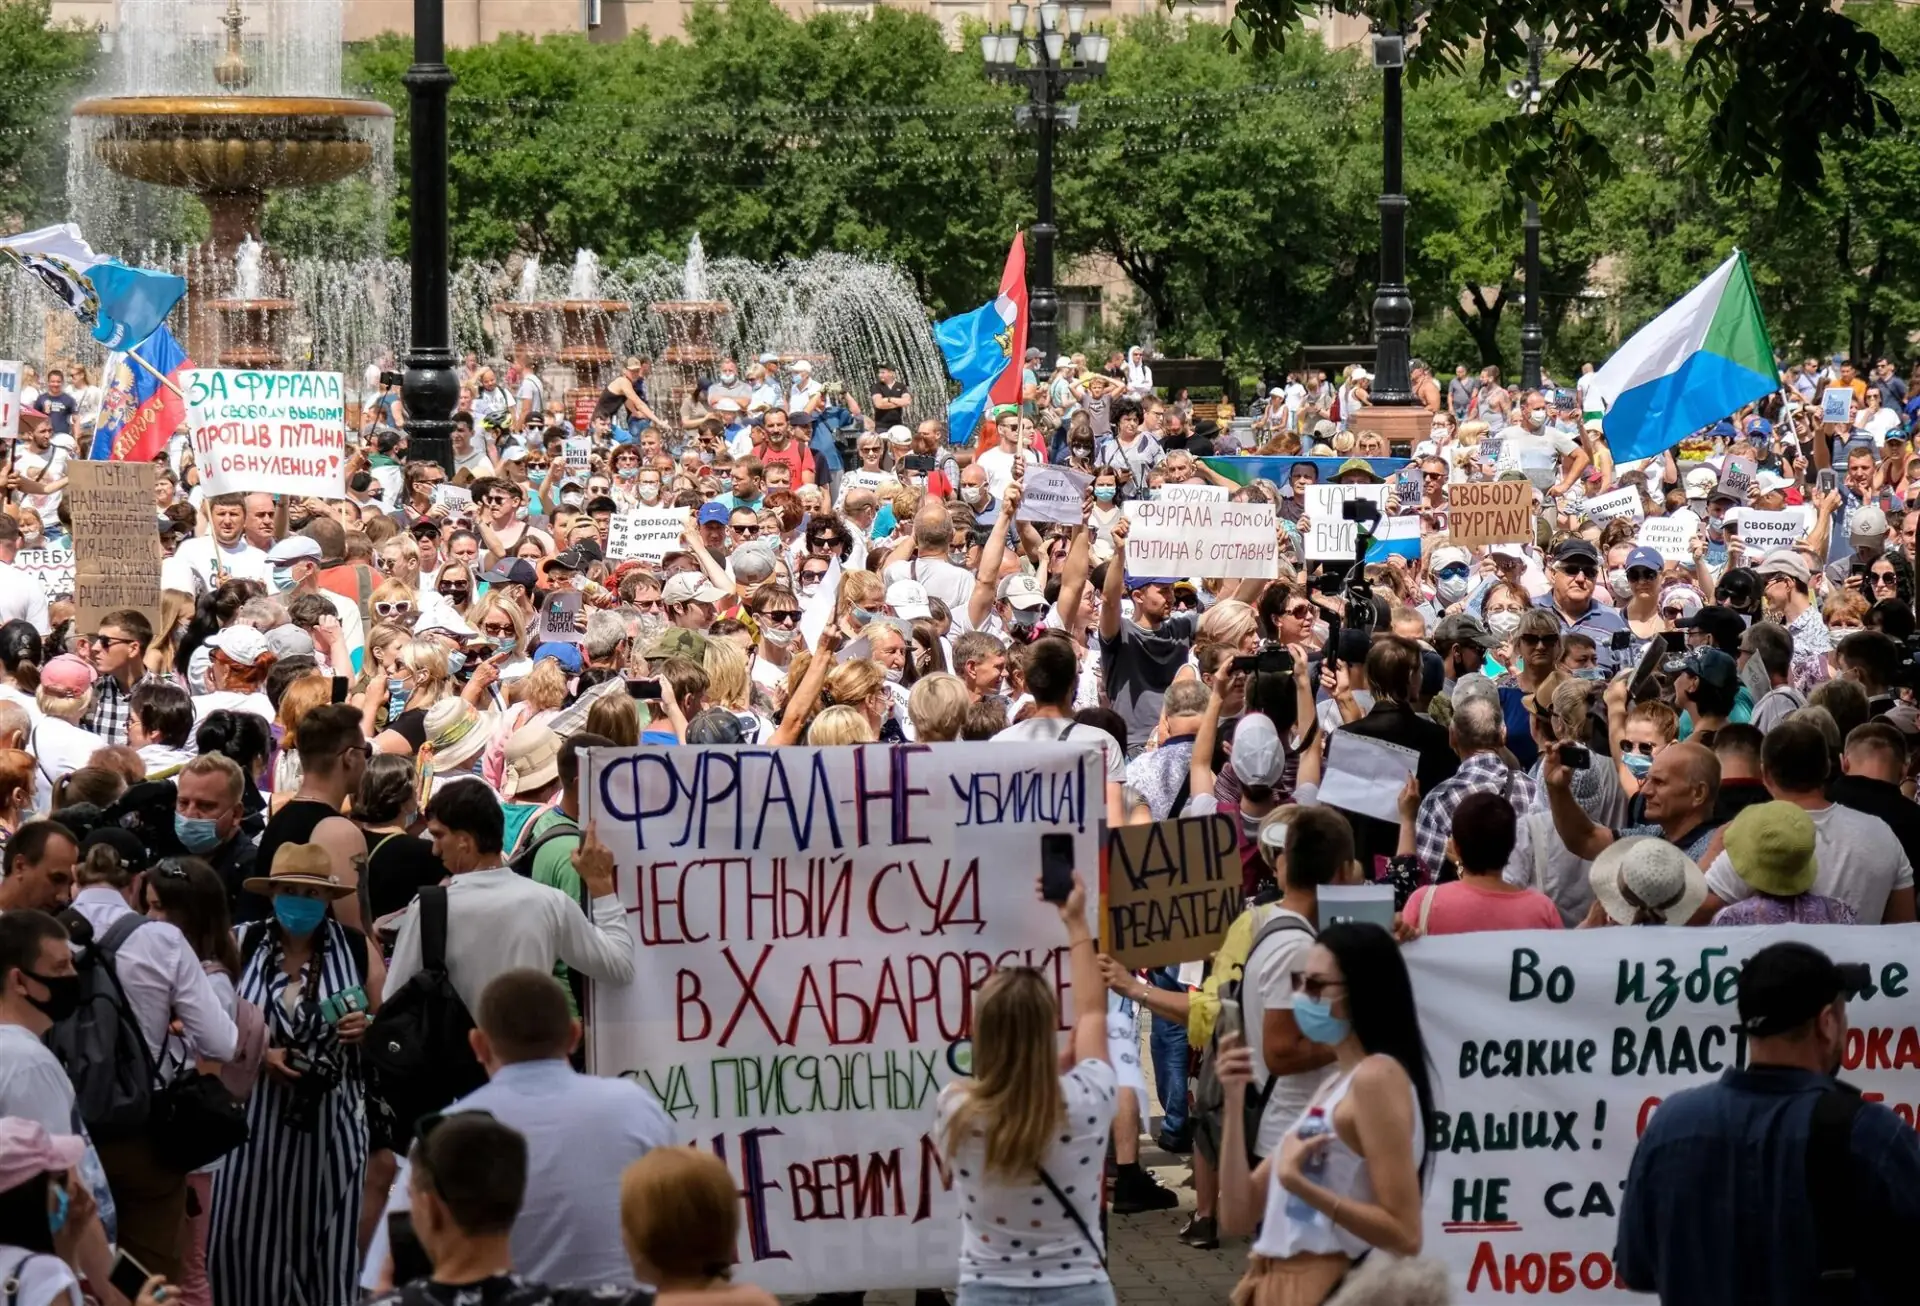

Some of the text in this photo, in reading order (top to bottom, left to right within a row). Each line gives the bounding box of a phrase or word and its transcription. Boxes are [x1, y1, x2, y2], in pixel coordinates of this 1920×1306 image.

[190, 371, 339, 406] ЗА ФУРГАЛА
[220, 404, 286, 419] СВОБОДУ
[196, 422, 343, 453] ПРОТИВ ПУТИНА
[221, 454, 340, 479] ОБНУЛЕНИЯ!
[1138, 503, 1212, 527] ФУРГАЛА
[1450, 505, 1531, 538] ФУРГАЛУ!
[1591, 496, 1633, 515] СВОБОДУ
[634, 531, 680, 542] ФУРГАЛУ
[1744, 521, 1797, 532] СВОБОДУ
[1744, 536, 1794, 546] ФУРГАЛУ
[1128, 539, 1189, 561] ПУТИНА
[1210, 543, 1275, 561] ОТСТАВКУ
[949, 755, 1087, 832] УБИЙЦА!
[1108, 812, 1238, 891] ЛДПР
[611, 854, 987, 946] ЧЕСТНЫЙ СУД
[1509, 947, 1576, 1004] Во
[710, 1048, 941, 1118] ПРИСЯЖНЫХ
[788, 1146, 906, 1222] ВЕРИМ
[1451, 1178, 1511, 1222] НЕ
